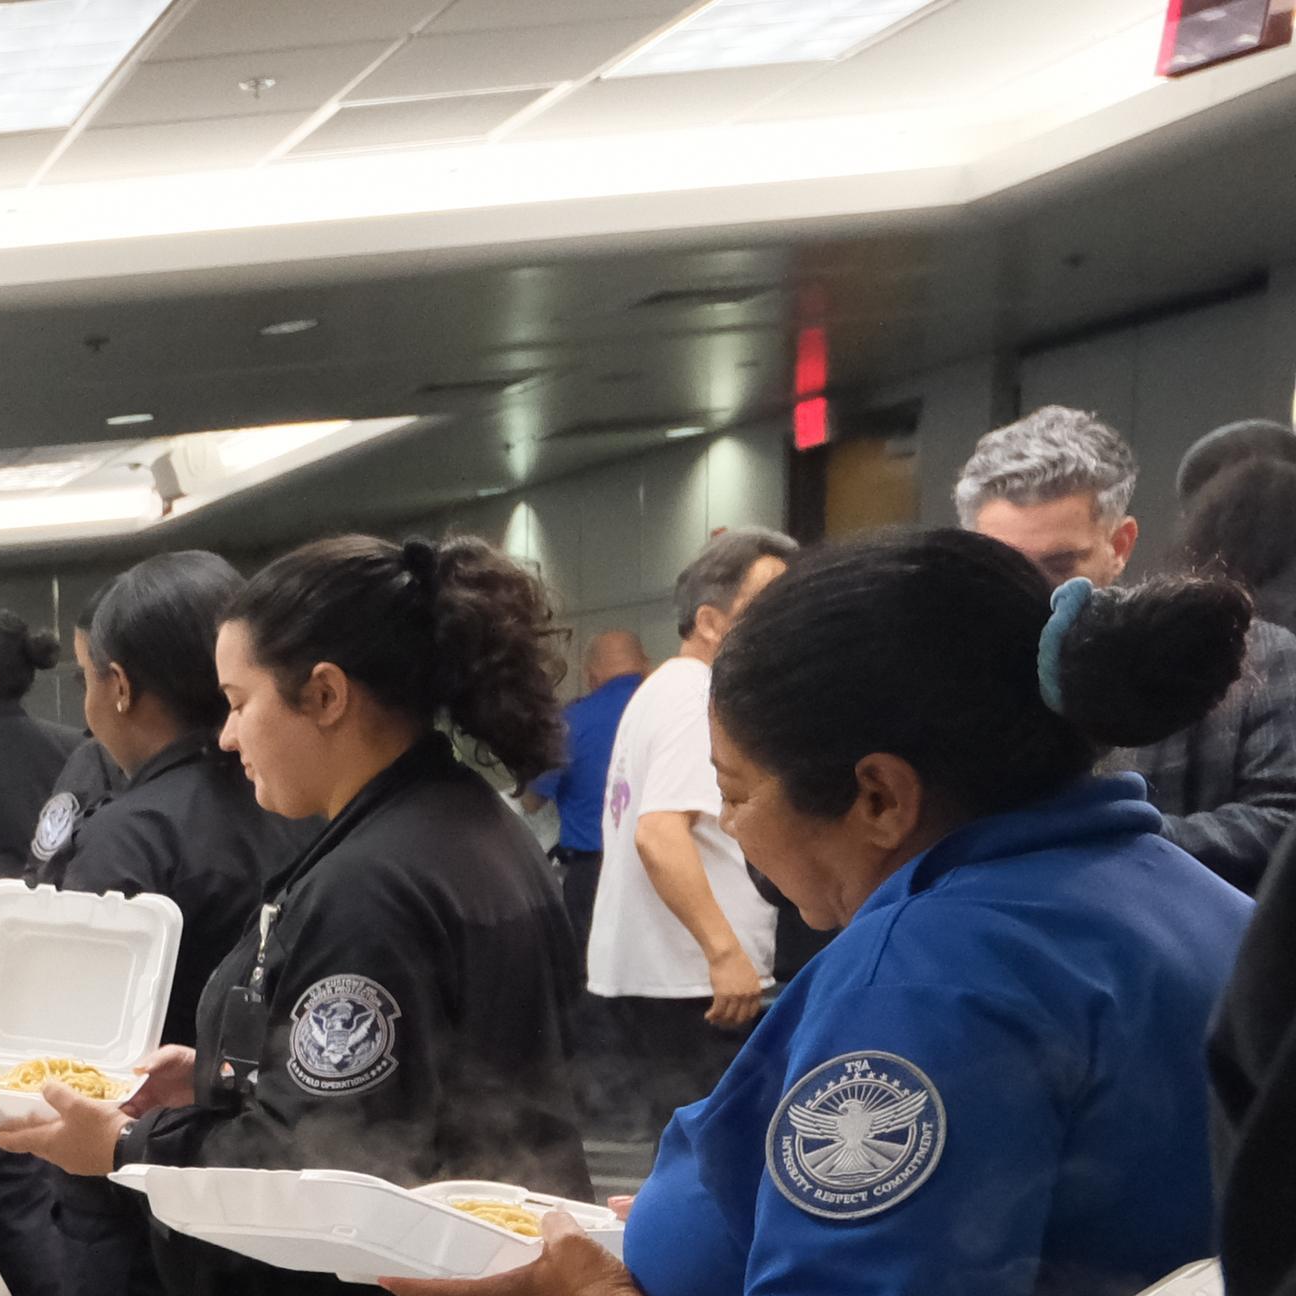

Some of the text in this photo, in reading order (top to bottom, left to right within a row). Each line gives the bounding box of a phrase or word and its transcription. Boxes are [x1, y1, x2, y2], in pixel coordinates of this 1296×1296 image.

[844, 1059, 871, 1073] TSA
[782, 1121, 933, 1204] INTEGRITY RESPECT COMMITMENT
